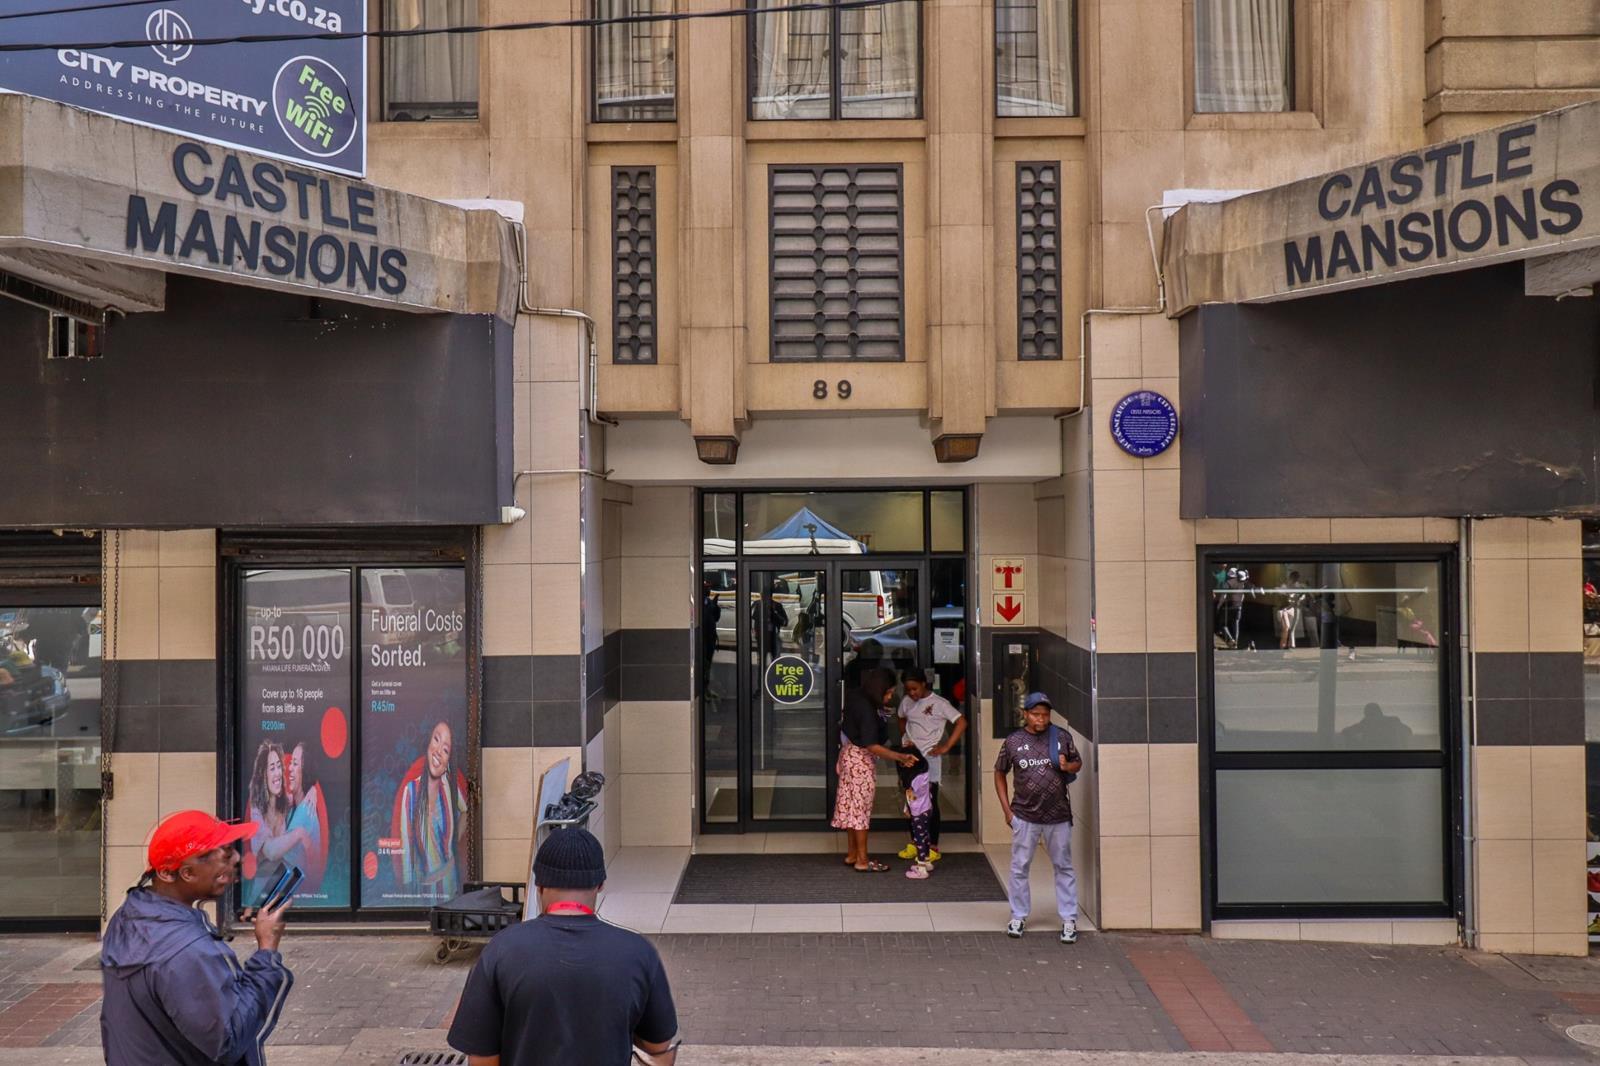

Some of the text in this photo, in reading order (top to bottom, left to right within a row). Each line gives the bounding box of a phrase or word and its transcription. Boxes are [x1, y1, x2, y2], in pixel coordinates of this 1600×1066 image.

[242, 0, 342, 33] y.co.za
[57, 48, 268, 117] CITY PROPERTY
[298, 64, 346, 114] Free
[59, 74, 264, 134] ADDRESSING THE FUTURE
[285, 98, 334, 149] WiFi
[172, 142, 377, 236] CASTLE
[1317, 123, 1537, 222] CASTLE
[126, 193, 408, 295] MANSIONS
[1284, 179, 1583, 287] MANSIONS
[371, 609, 463, 632] Funeral Costs
[250, 624, 344, 660] R50 000
[371, 644, 426, 667] Sorted.
[775, 664, 804, 675] Free
[262, 688, 279, 699] Cover
[280, 690, 288, 700] up
[288, 688, 295, 698] to
[304, 688, 324, 701] people
[262, 702, 305, 713] from as little as
[775, 683, 804, 696] WiFi
[1028, 758, 1051, 766] Disco
